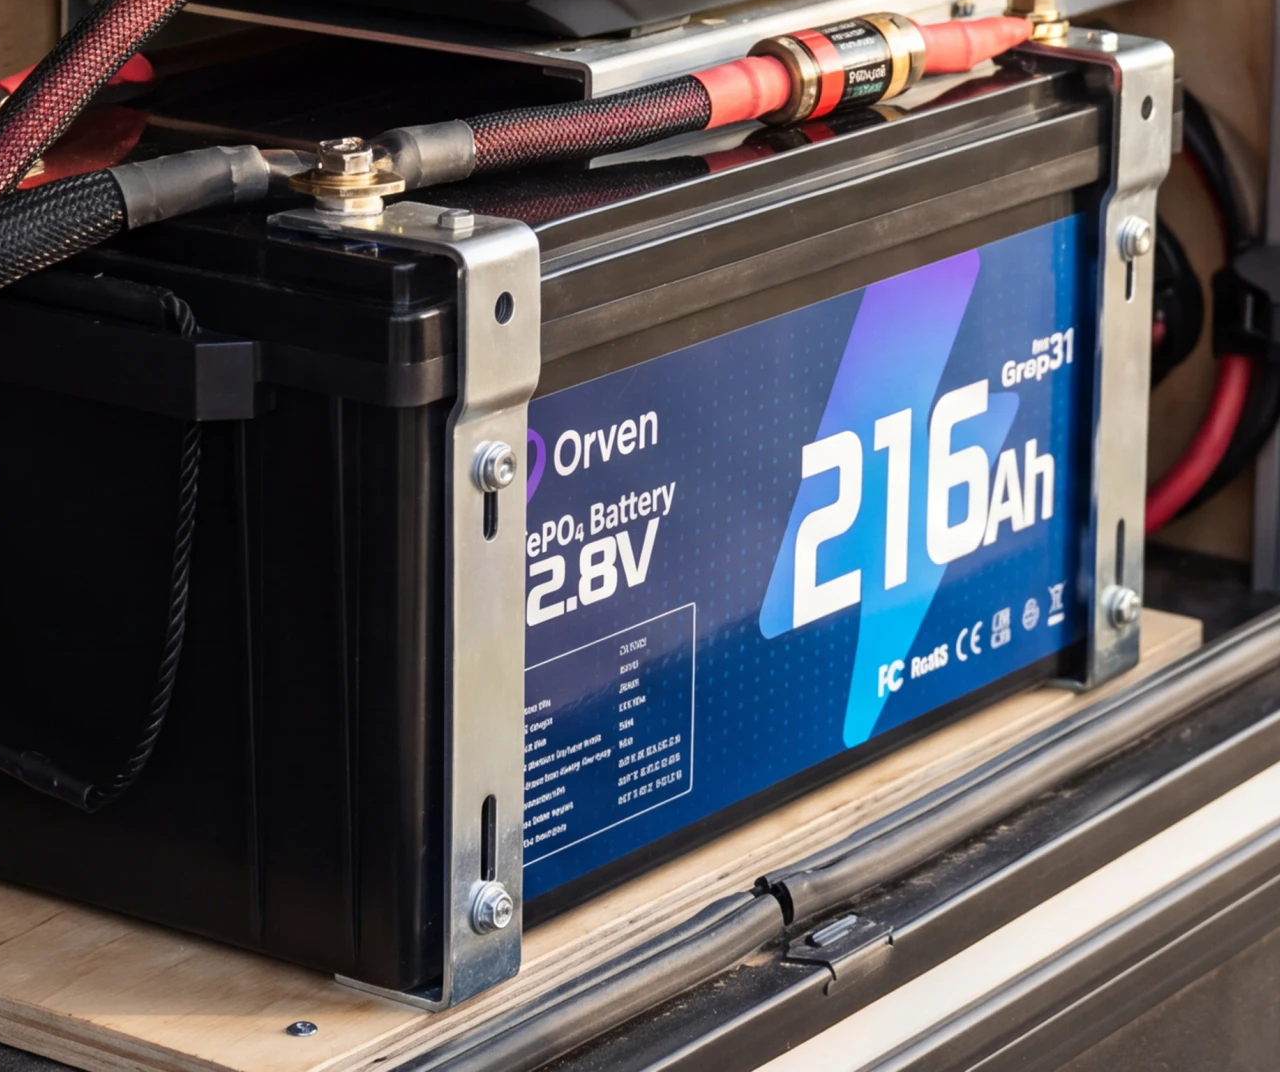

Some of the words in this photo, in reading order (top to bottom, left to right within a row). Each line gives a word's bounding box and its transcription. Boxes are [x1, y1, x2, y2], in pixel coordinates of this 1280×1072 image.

[553, 410, 658, 477] Orven
[525, 514, 584, 558] ePO4
[590, 481, 676, 536] Battery
